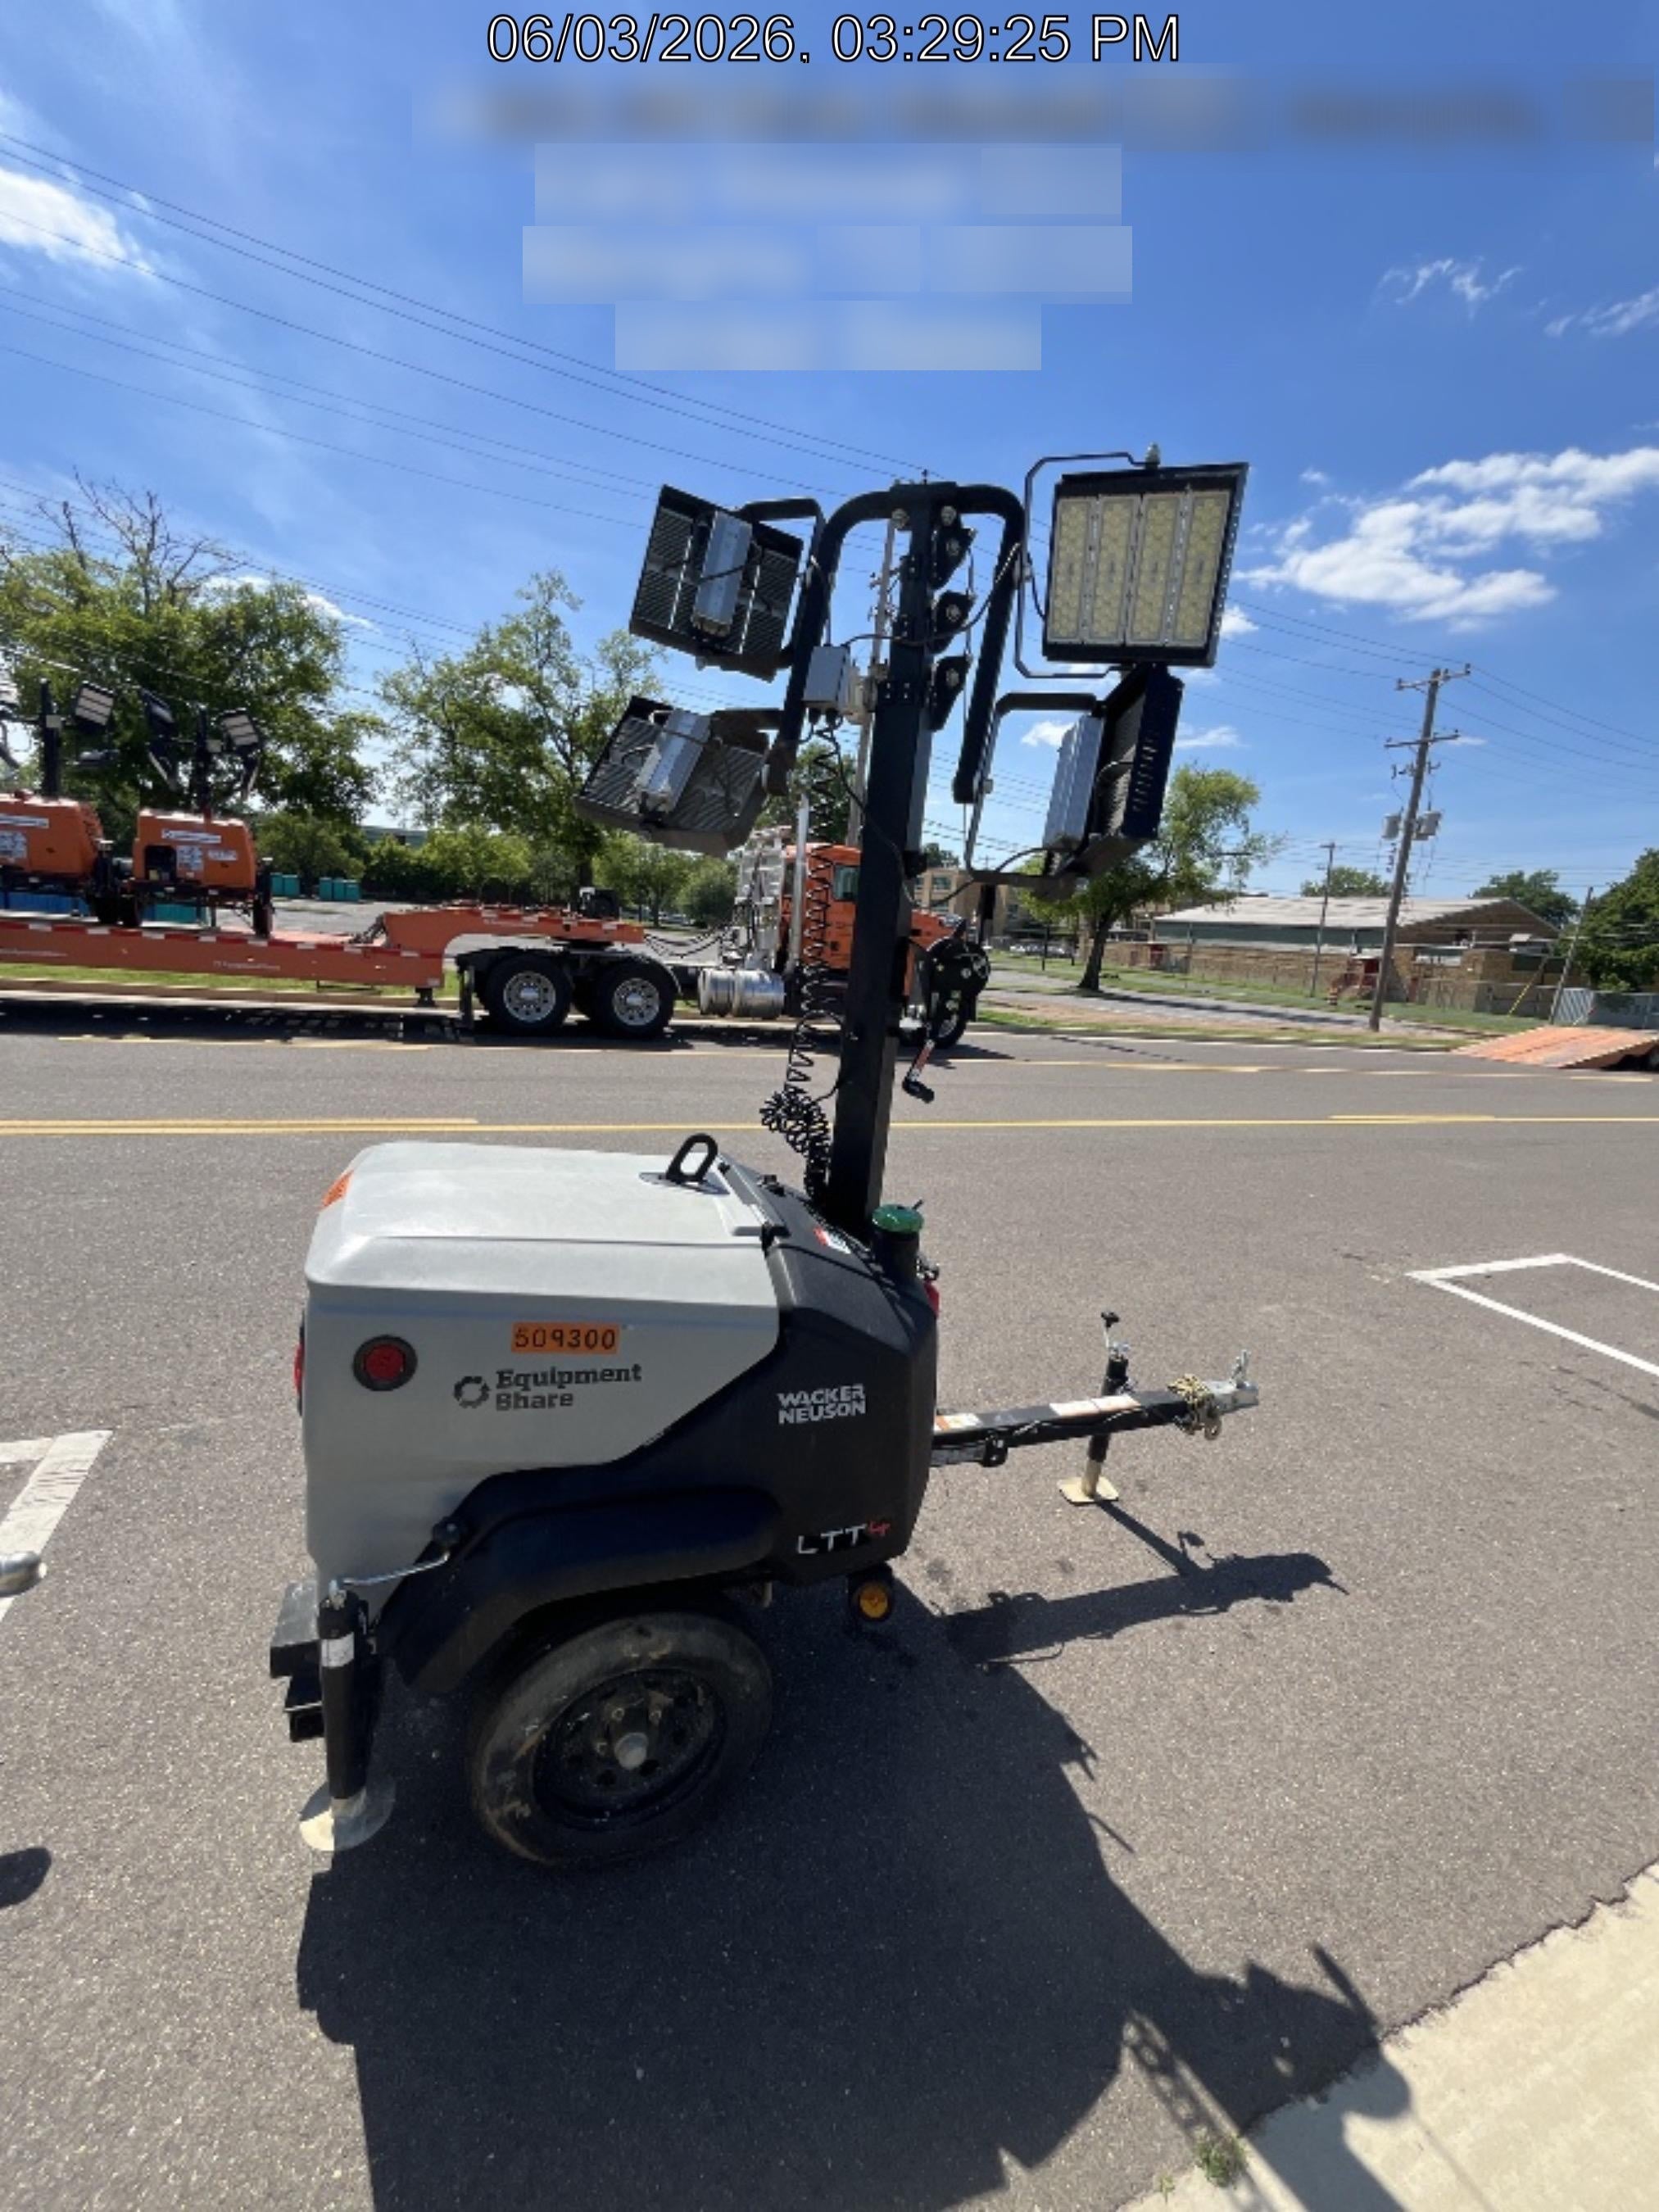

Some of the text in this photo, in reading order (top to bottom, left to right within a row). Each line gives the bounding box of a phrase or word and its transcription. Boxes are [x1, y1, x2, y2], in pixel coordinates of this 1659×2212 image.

[514, 1327, 615, 1350] 509300
[496, 1363, 641, 1391] Equipment
[496, 1393, 573, 1411] Share
[777, 1383, 866, 1407] WACKER
[778, 1401, 866, 1425] NEUSON
